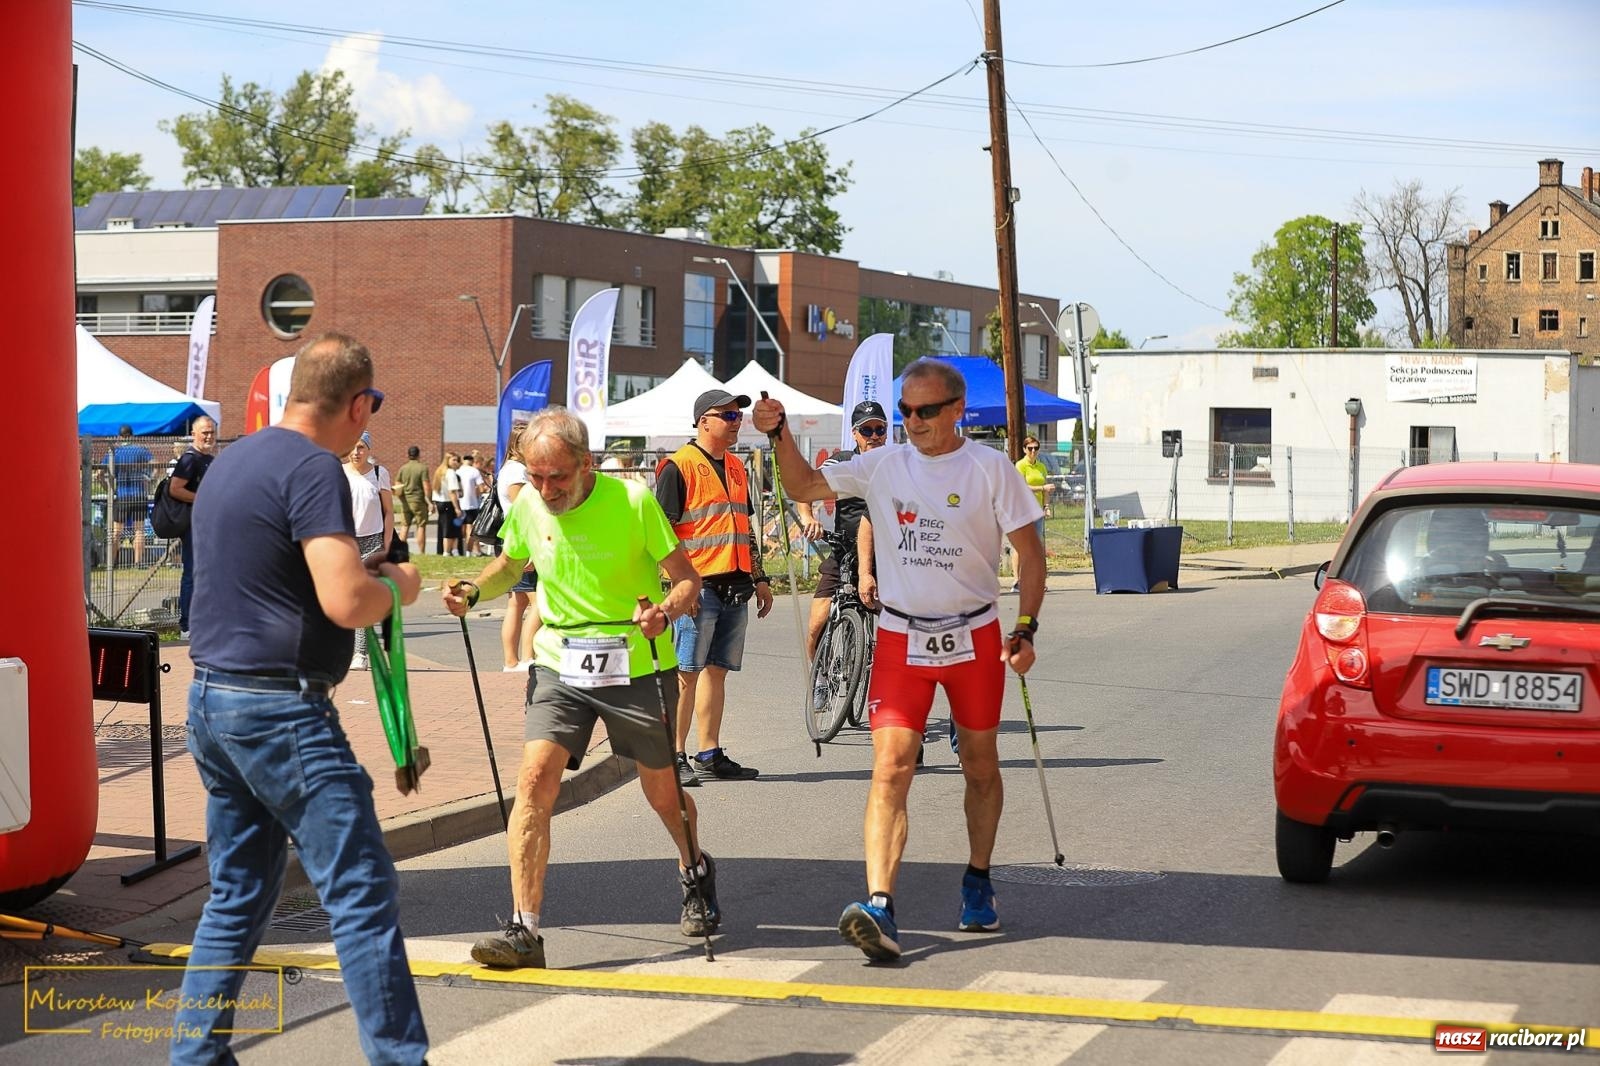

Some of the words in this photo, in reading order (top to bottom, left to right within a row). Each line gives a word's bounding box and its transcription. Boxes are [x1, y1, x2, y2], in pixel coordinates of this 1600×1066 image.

[574, 338, 598, 413] OSiR
[1390, 366, 1418, 376] Sekcja
[1420, 366, 1473, 375] Podnoszenia
[920, 518, 944, 530] BIEG
[920, 532, 941, 542] BEZ
[902, 557, 908, 566] 3
[926, 633, 955, 655] 46
[581, 653, 609, 673] 47
[1442, 671, 1490, 698] SWD
[1501, 674, 1577, 703] 18854
